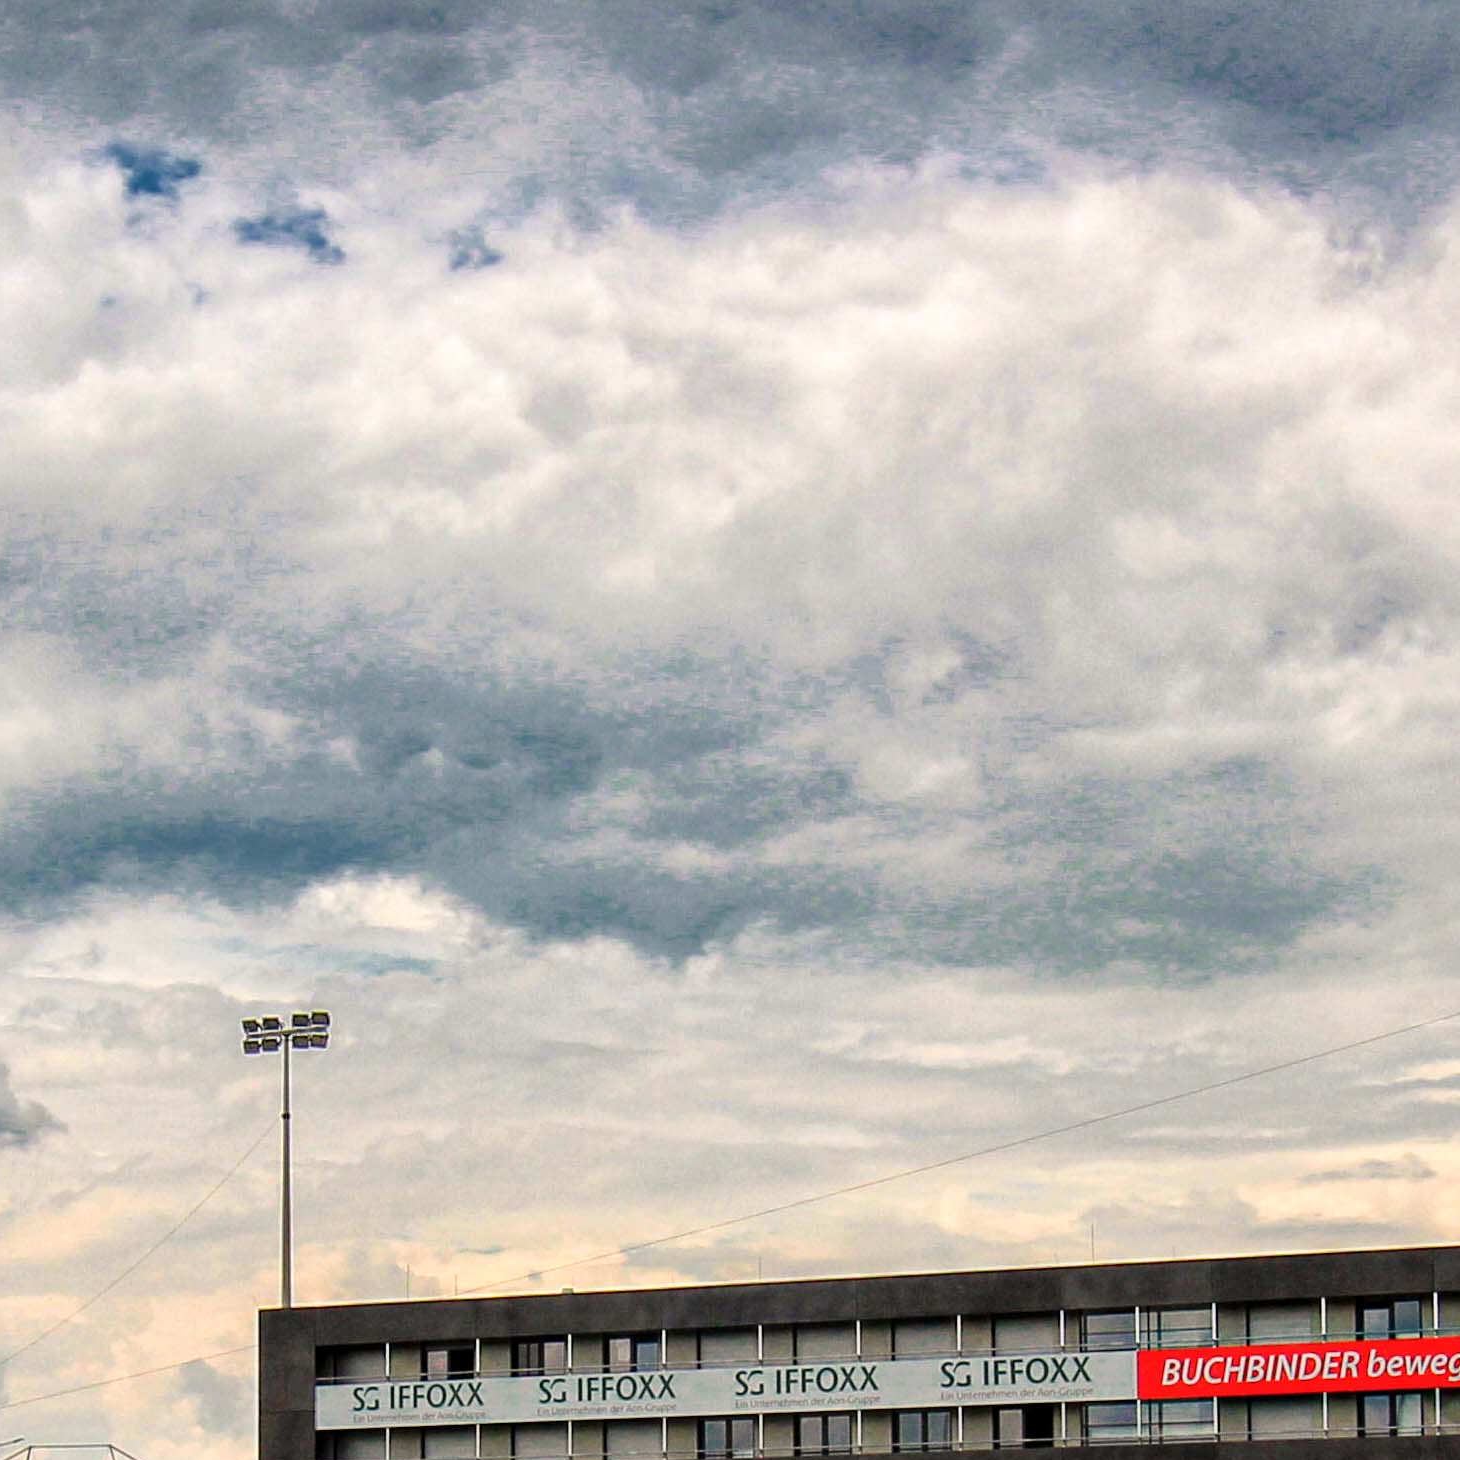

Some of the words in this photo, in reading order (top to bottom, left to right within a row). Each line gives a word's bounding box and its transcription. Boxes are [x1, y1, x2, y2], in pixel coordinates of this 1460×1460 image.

[734, 1369, 765, 1396] SG
[775, 1365, 879, 1394] IFFOXX
[940, 1360, 972, 1388] SG
[983, 1356, 1092, 1386] IFFOXX
[1161, 1353, 1360, 1386] BUCHBINDER
[352, 1385, 379, 1412] SG
[389, 1381, 484, 1409] IFFOXX
[539, 1377, 567, 1404] SG
[577, 1373, 676, 1403] IFFOXX
[750, 1397, 809, 1408] Unternehmen
[810, 1396, 826, 1406] der
[956, 1388, 1018, 1400] Unternehmen
[1020, 1387, 1037, 1398] der
